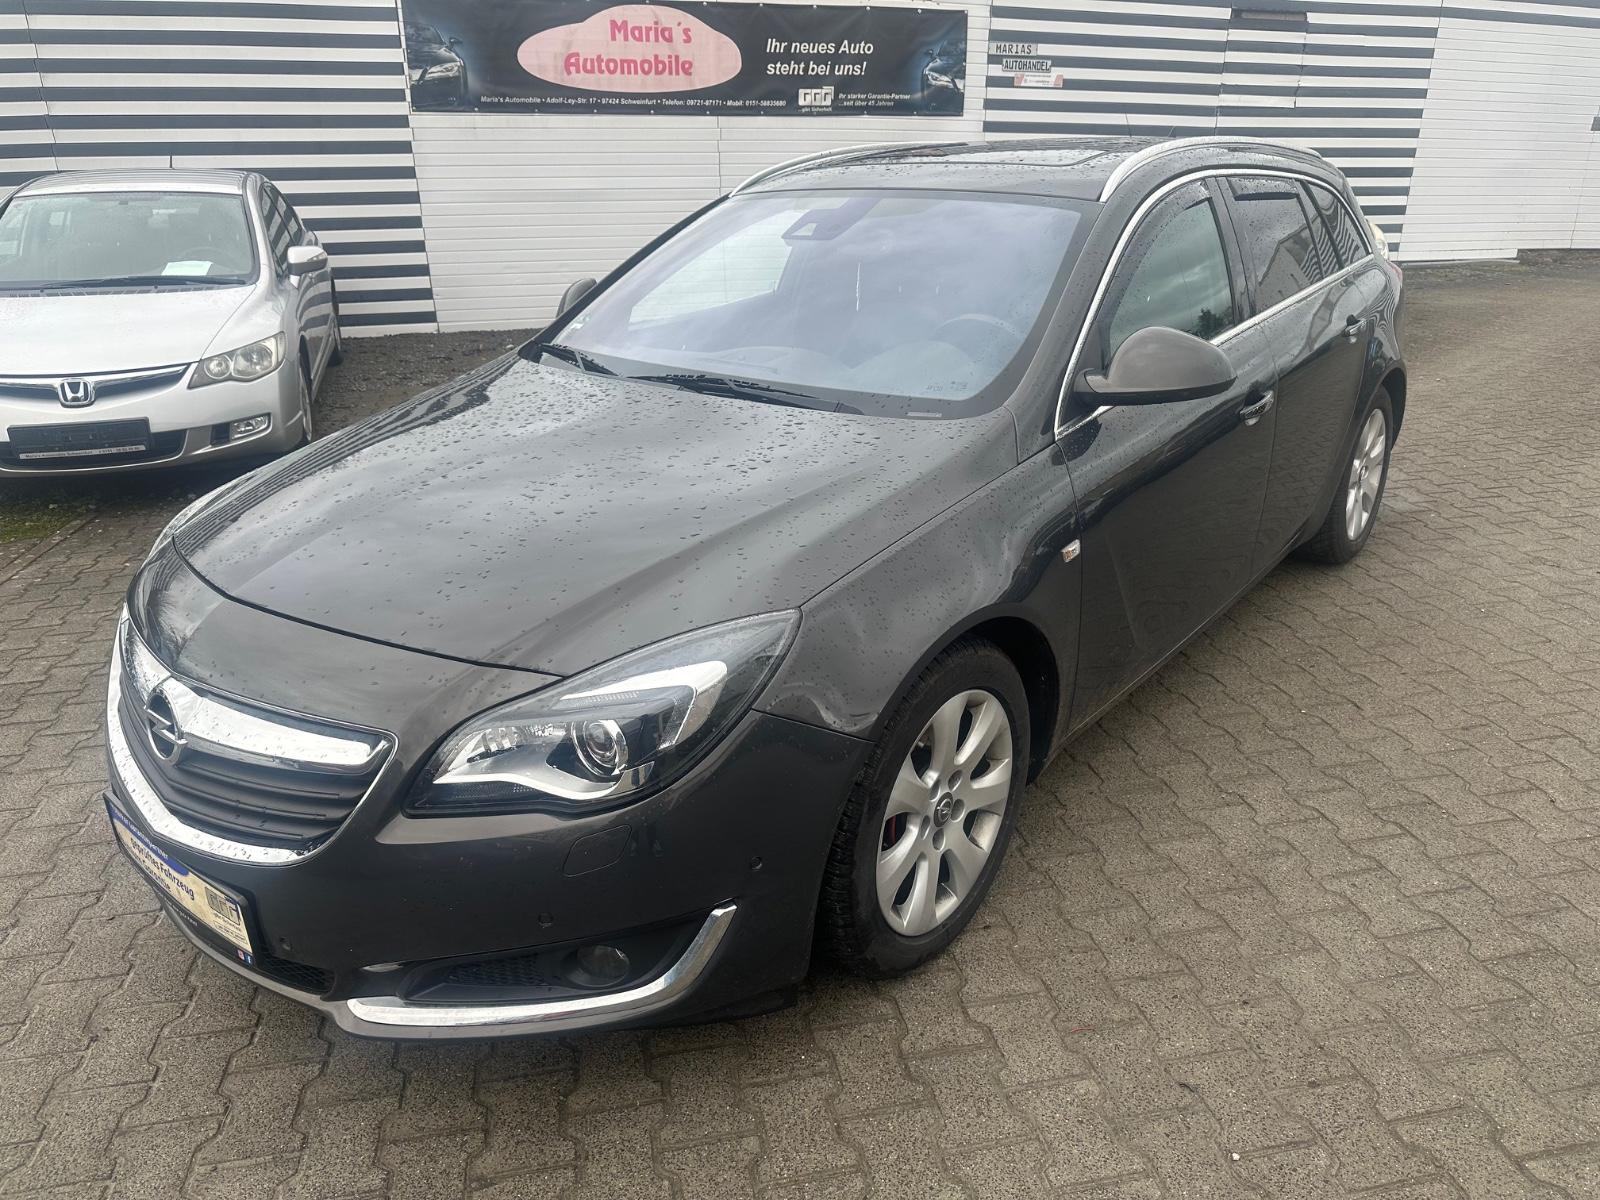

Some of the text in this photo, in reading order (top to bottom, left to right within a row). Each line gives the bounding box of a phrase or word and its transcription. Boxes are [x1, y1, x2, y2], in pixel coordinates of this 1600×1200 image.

[766, 38, 874, 55] Ihr neues Auto
[995, 43, 1032, 55] MARIAS
[564, 52, 694, 76] Automobile
[766, 61, 867, 75] steht bei uns!
[1003, 59, 1050, 71] AUTOHANDEL
[505, 96, 541, 104] Automobile
[159, 861, 195, 901] Fahrzeug
